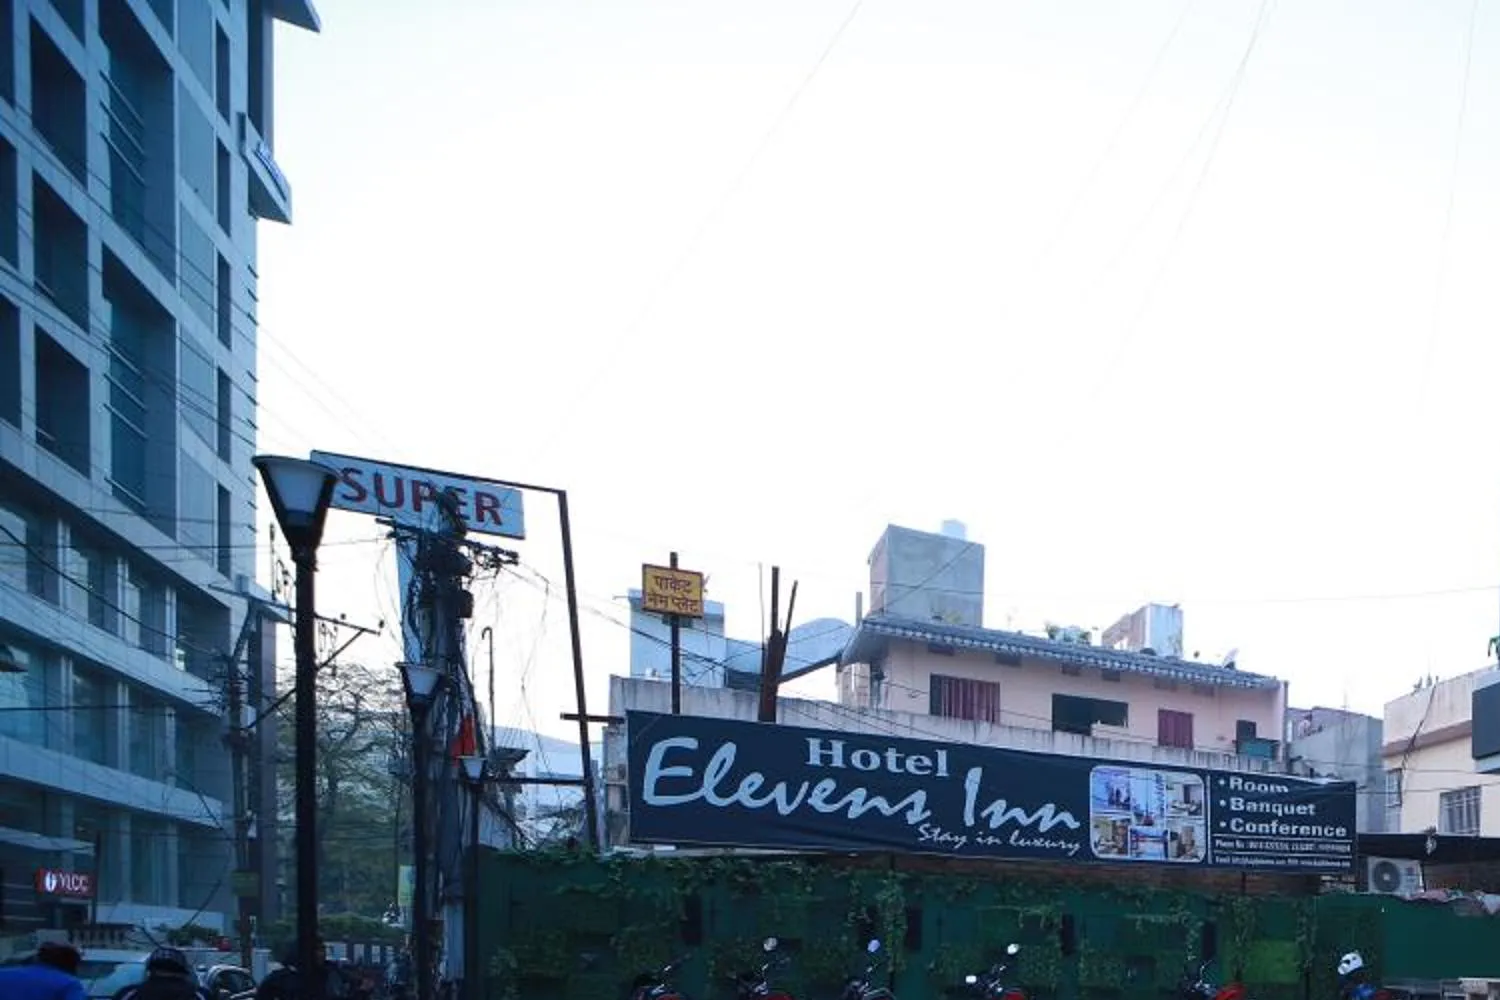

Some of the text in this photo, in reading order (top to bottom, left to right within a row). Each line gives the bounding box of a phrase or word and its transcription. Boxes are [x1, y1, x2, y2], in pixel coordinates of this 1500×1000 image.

[804, 737, 949, 777] Hotel
[642, 736, 1081, 833] Elevens Inn
[1229, 776, 1289, 793] Room
[1229, 797, 1317, 817] Banquet
[917, 823, 1081, 857] Stay in luxury
[1229, 817, 1347, 837] Conference
